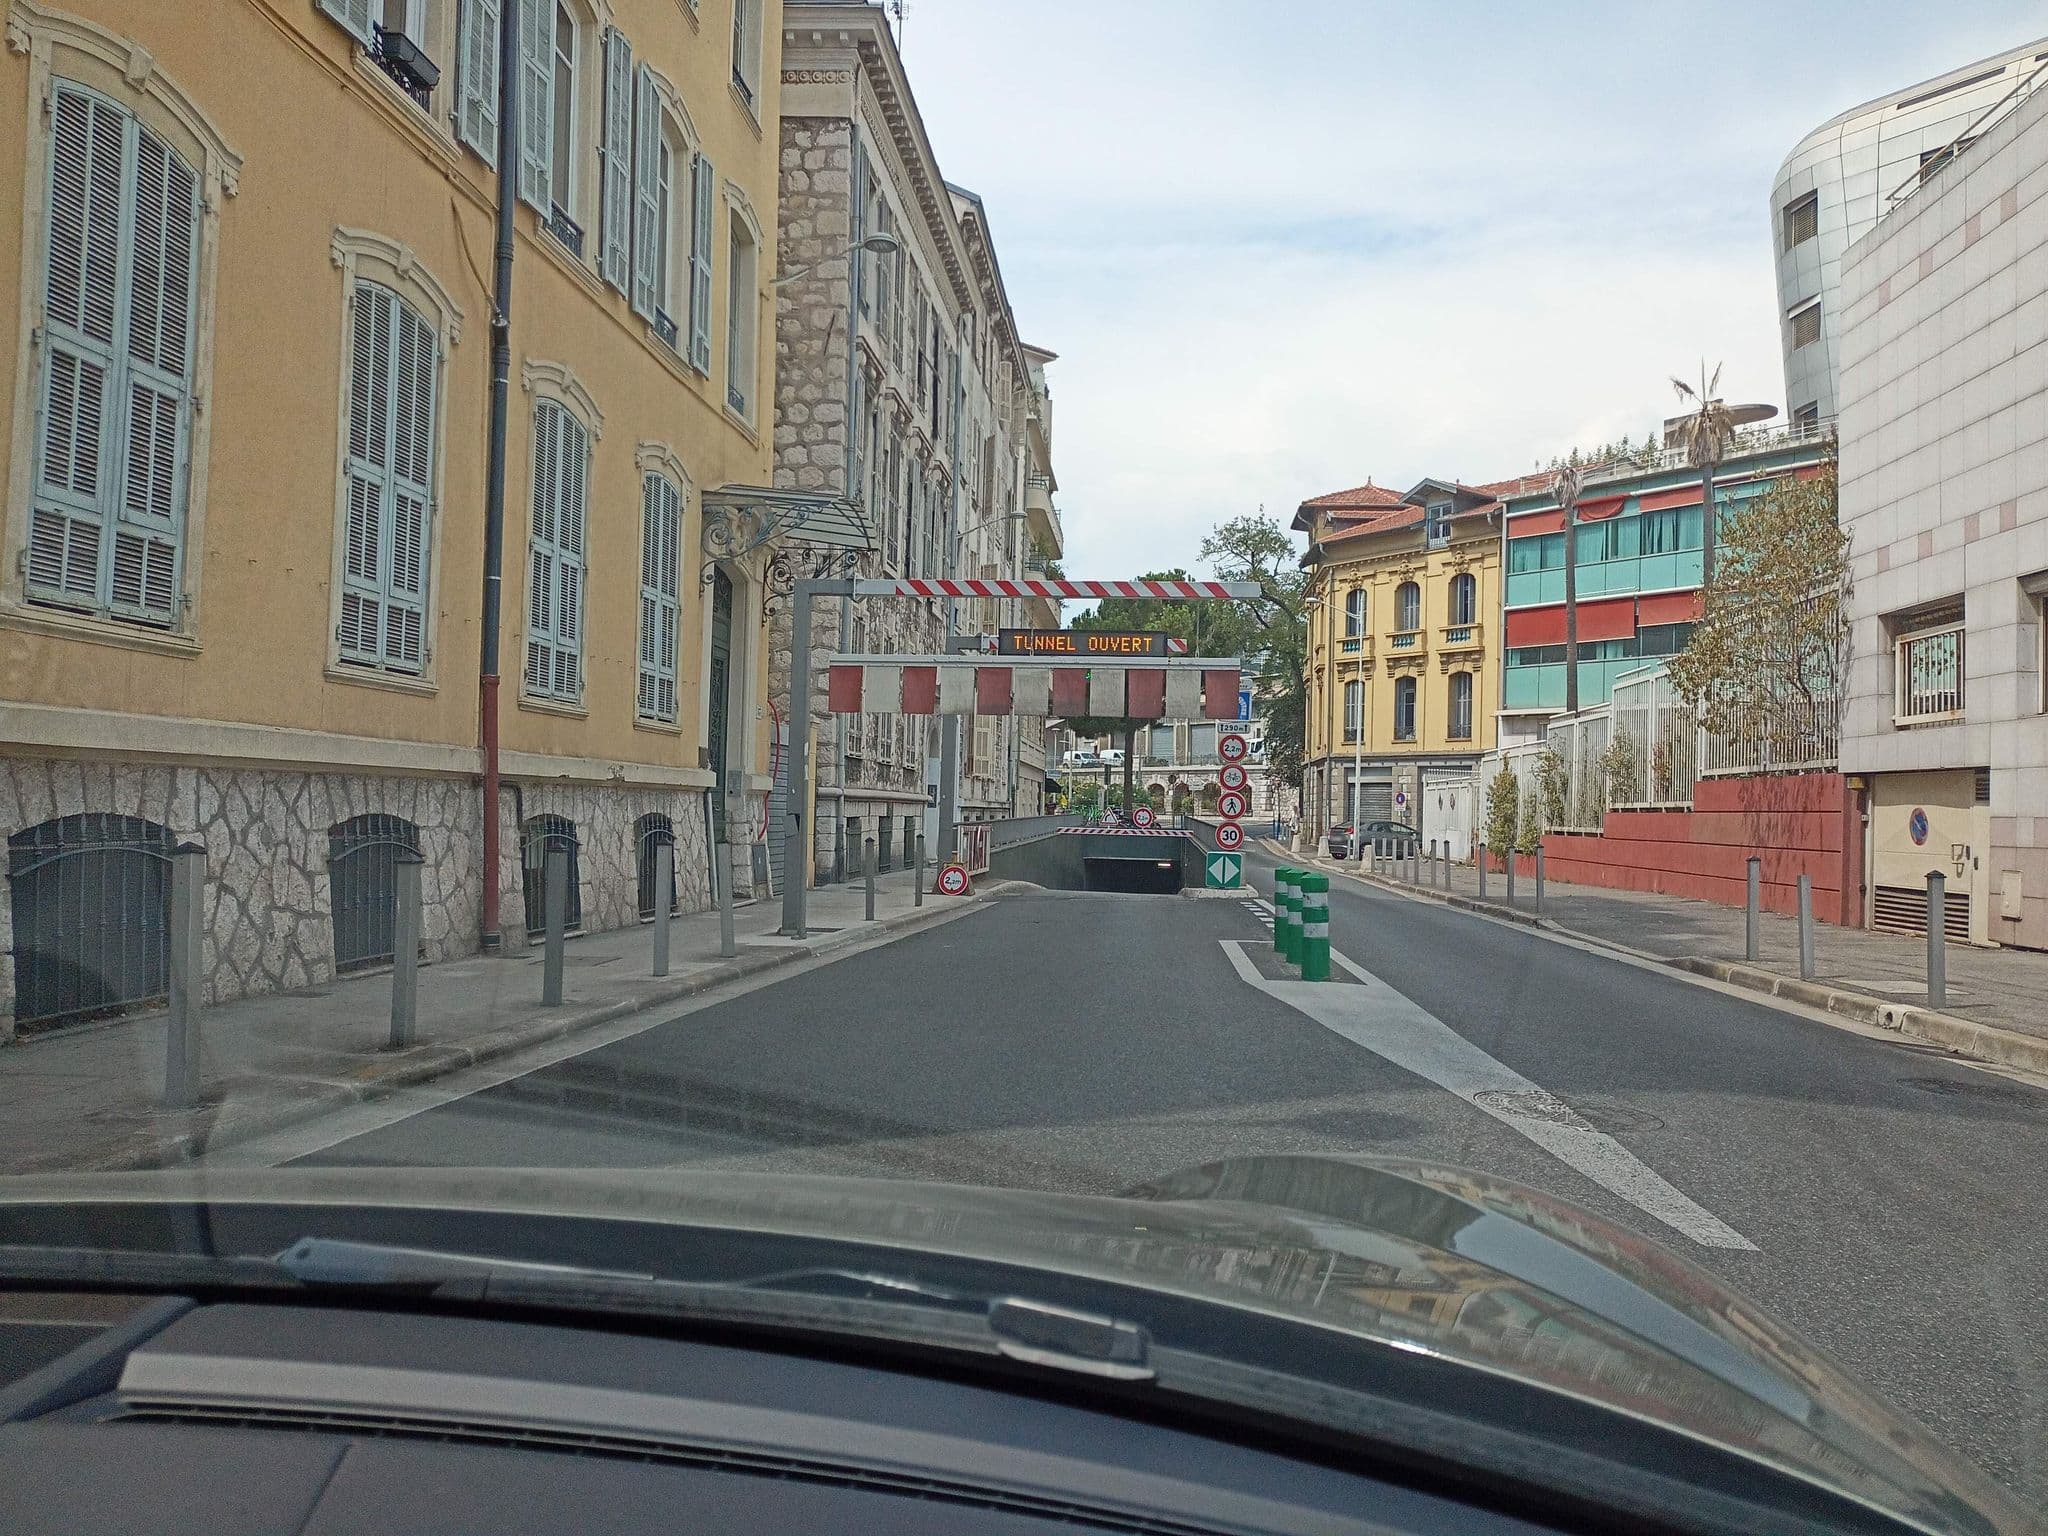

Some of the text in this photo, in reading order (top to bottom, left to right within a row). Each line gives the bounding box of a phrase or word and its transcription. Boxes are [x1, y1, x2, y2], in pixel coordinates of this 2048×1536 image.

[1014, 636, 1152, 652] TUNNEL OUVERT
[1224, 744, 1242, 752] 2,2m
[1222, 830, 1238, 841] 30
